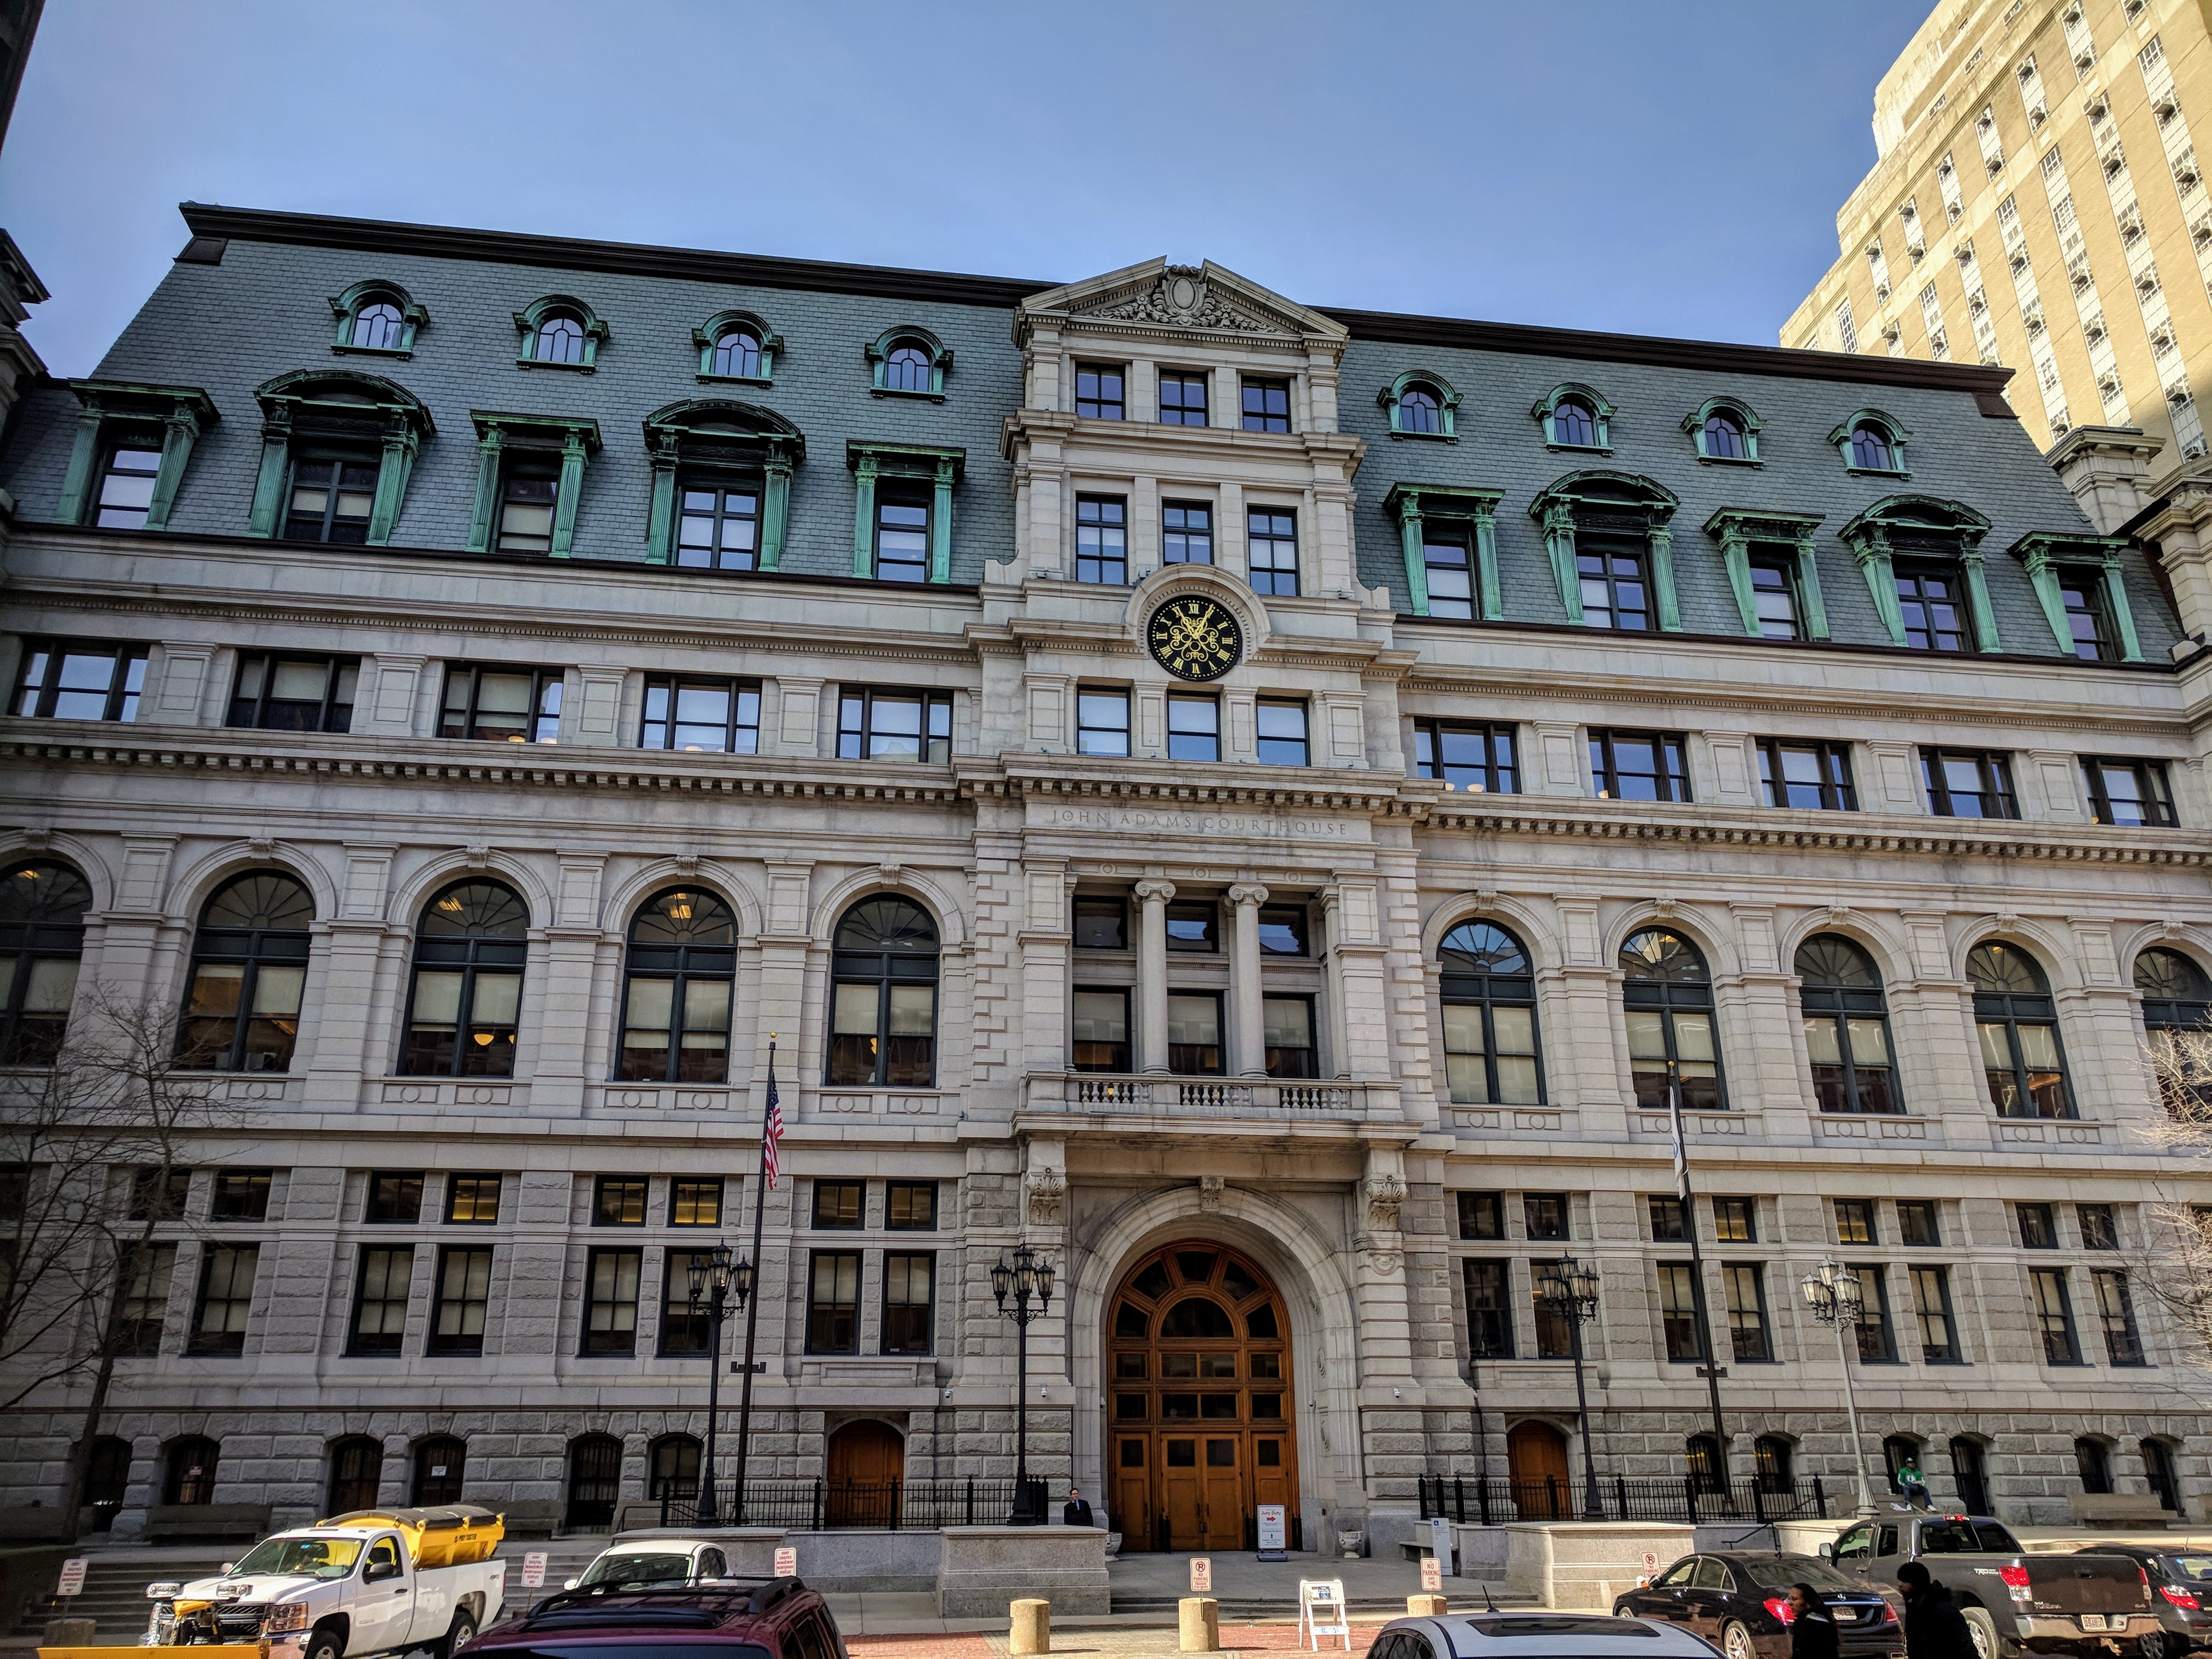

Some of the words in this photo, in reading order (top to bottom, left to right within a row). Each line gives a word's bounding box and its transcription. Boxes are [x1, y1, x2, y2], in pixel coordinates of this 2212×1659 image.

[1188, 603, 1199, 614] XII
[1217, 621, 1228, 630] II
[1222, 637, 1233, 645] III
[1192, 663, 1201, 674] VI
[1208, 660, 1217, 670] V
[1052, 810, 1107, 823] JOHN
[1121, 814, 1191, 827] ADAMS
[1204, 817, 1346, 834] COURTHOUSE
